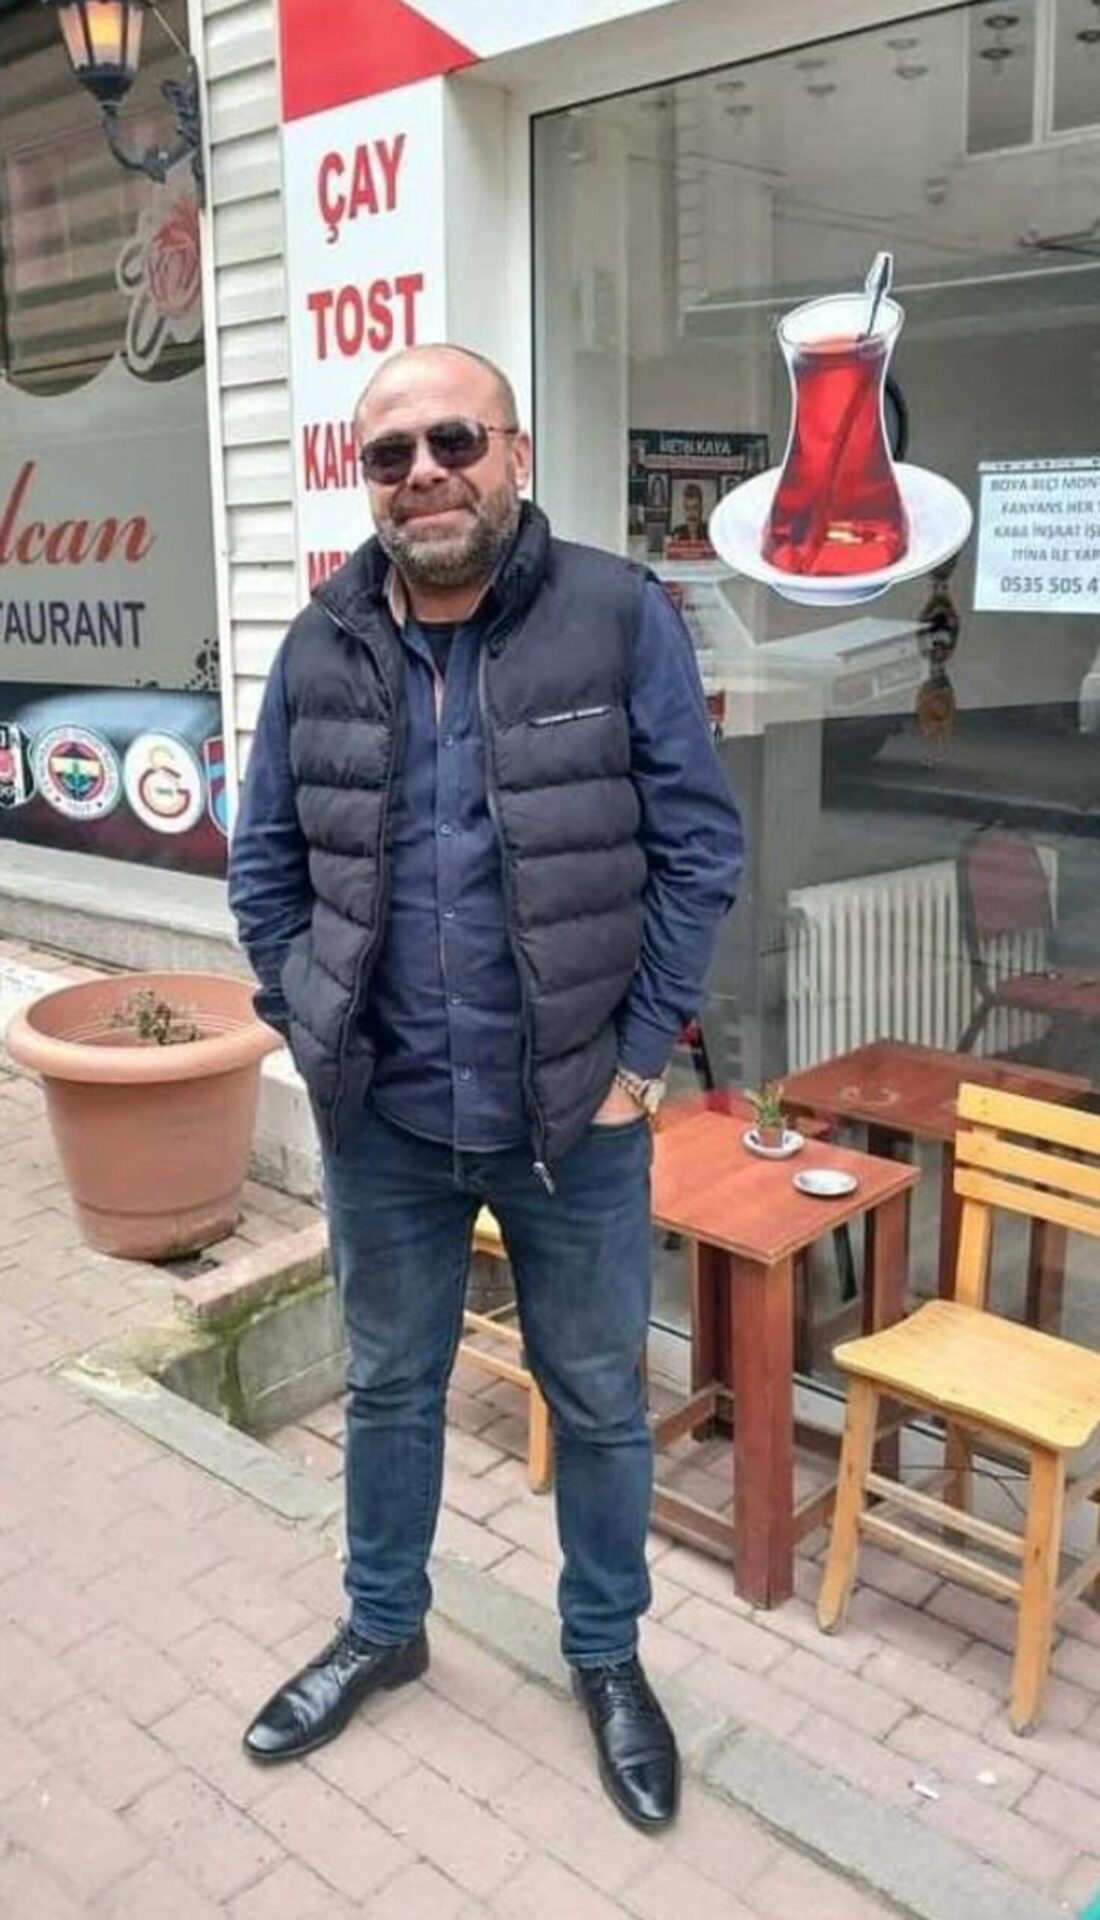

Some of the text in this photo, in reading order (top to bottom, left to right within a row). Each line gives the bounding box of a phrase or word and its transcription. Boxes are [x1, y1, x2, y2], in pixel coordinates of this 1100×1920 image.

[318, 133, 406, 244] ÇAY
[308, 273, 424, 360] TOST
[1000, 576, 1043, 593] 0535
[1047, 576, 1082, 594] 505
[0, 600, 145, 648] AURANT
